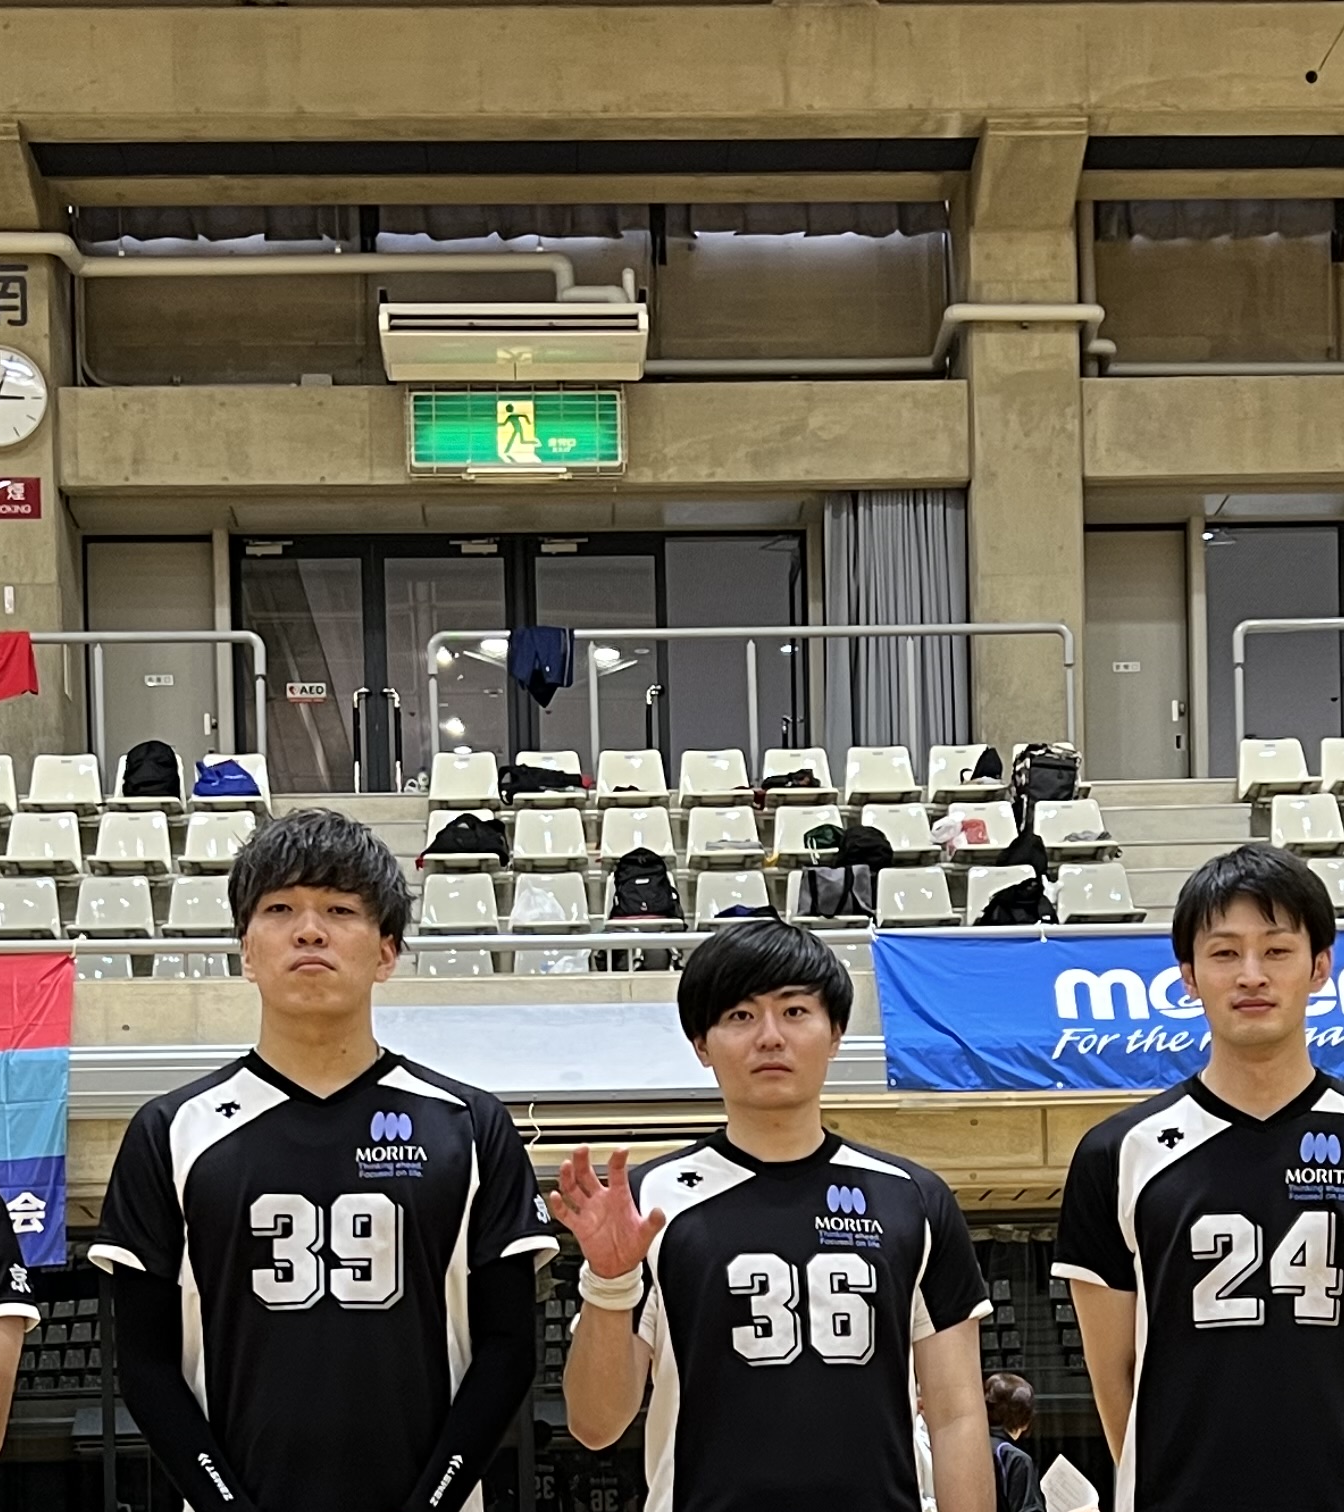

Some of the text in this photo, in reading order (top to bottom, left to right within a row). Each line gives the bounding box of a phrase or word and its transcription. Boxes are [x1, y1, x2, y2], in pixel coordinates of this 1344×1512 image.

[299, 685, 325, 695] AED
[1052, 1027, 1121, 1060] For
[1126, 1024, 1197, 1054] the
[356, 1145, 427, 1162] MORITA
[6, 1191, 46, 1234] 会
[815, 1216, 884, 1234] MORITA
[250, 1193, 404, 1311] 39
[1190, 1211, 1344, 1329] 24
[727, 1253, 877, 1367] 36
